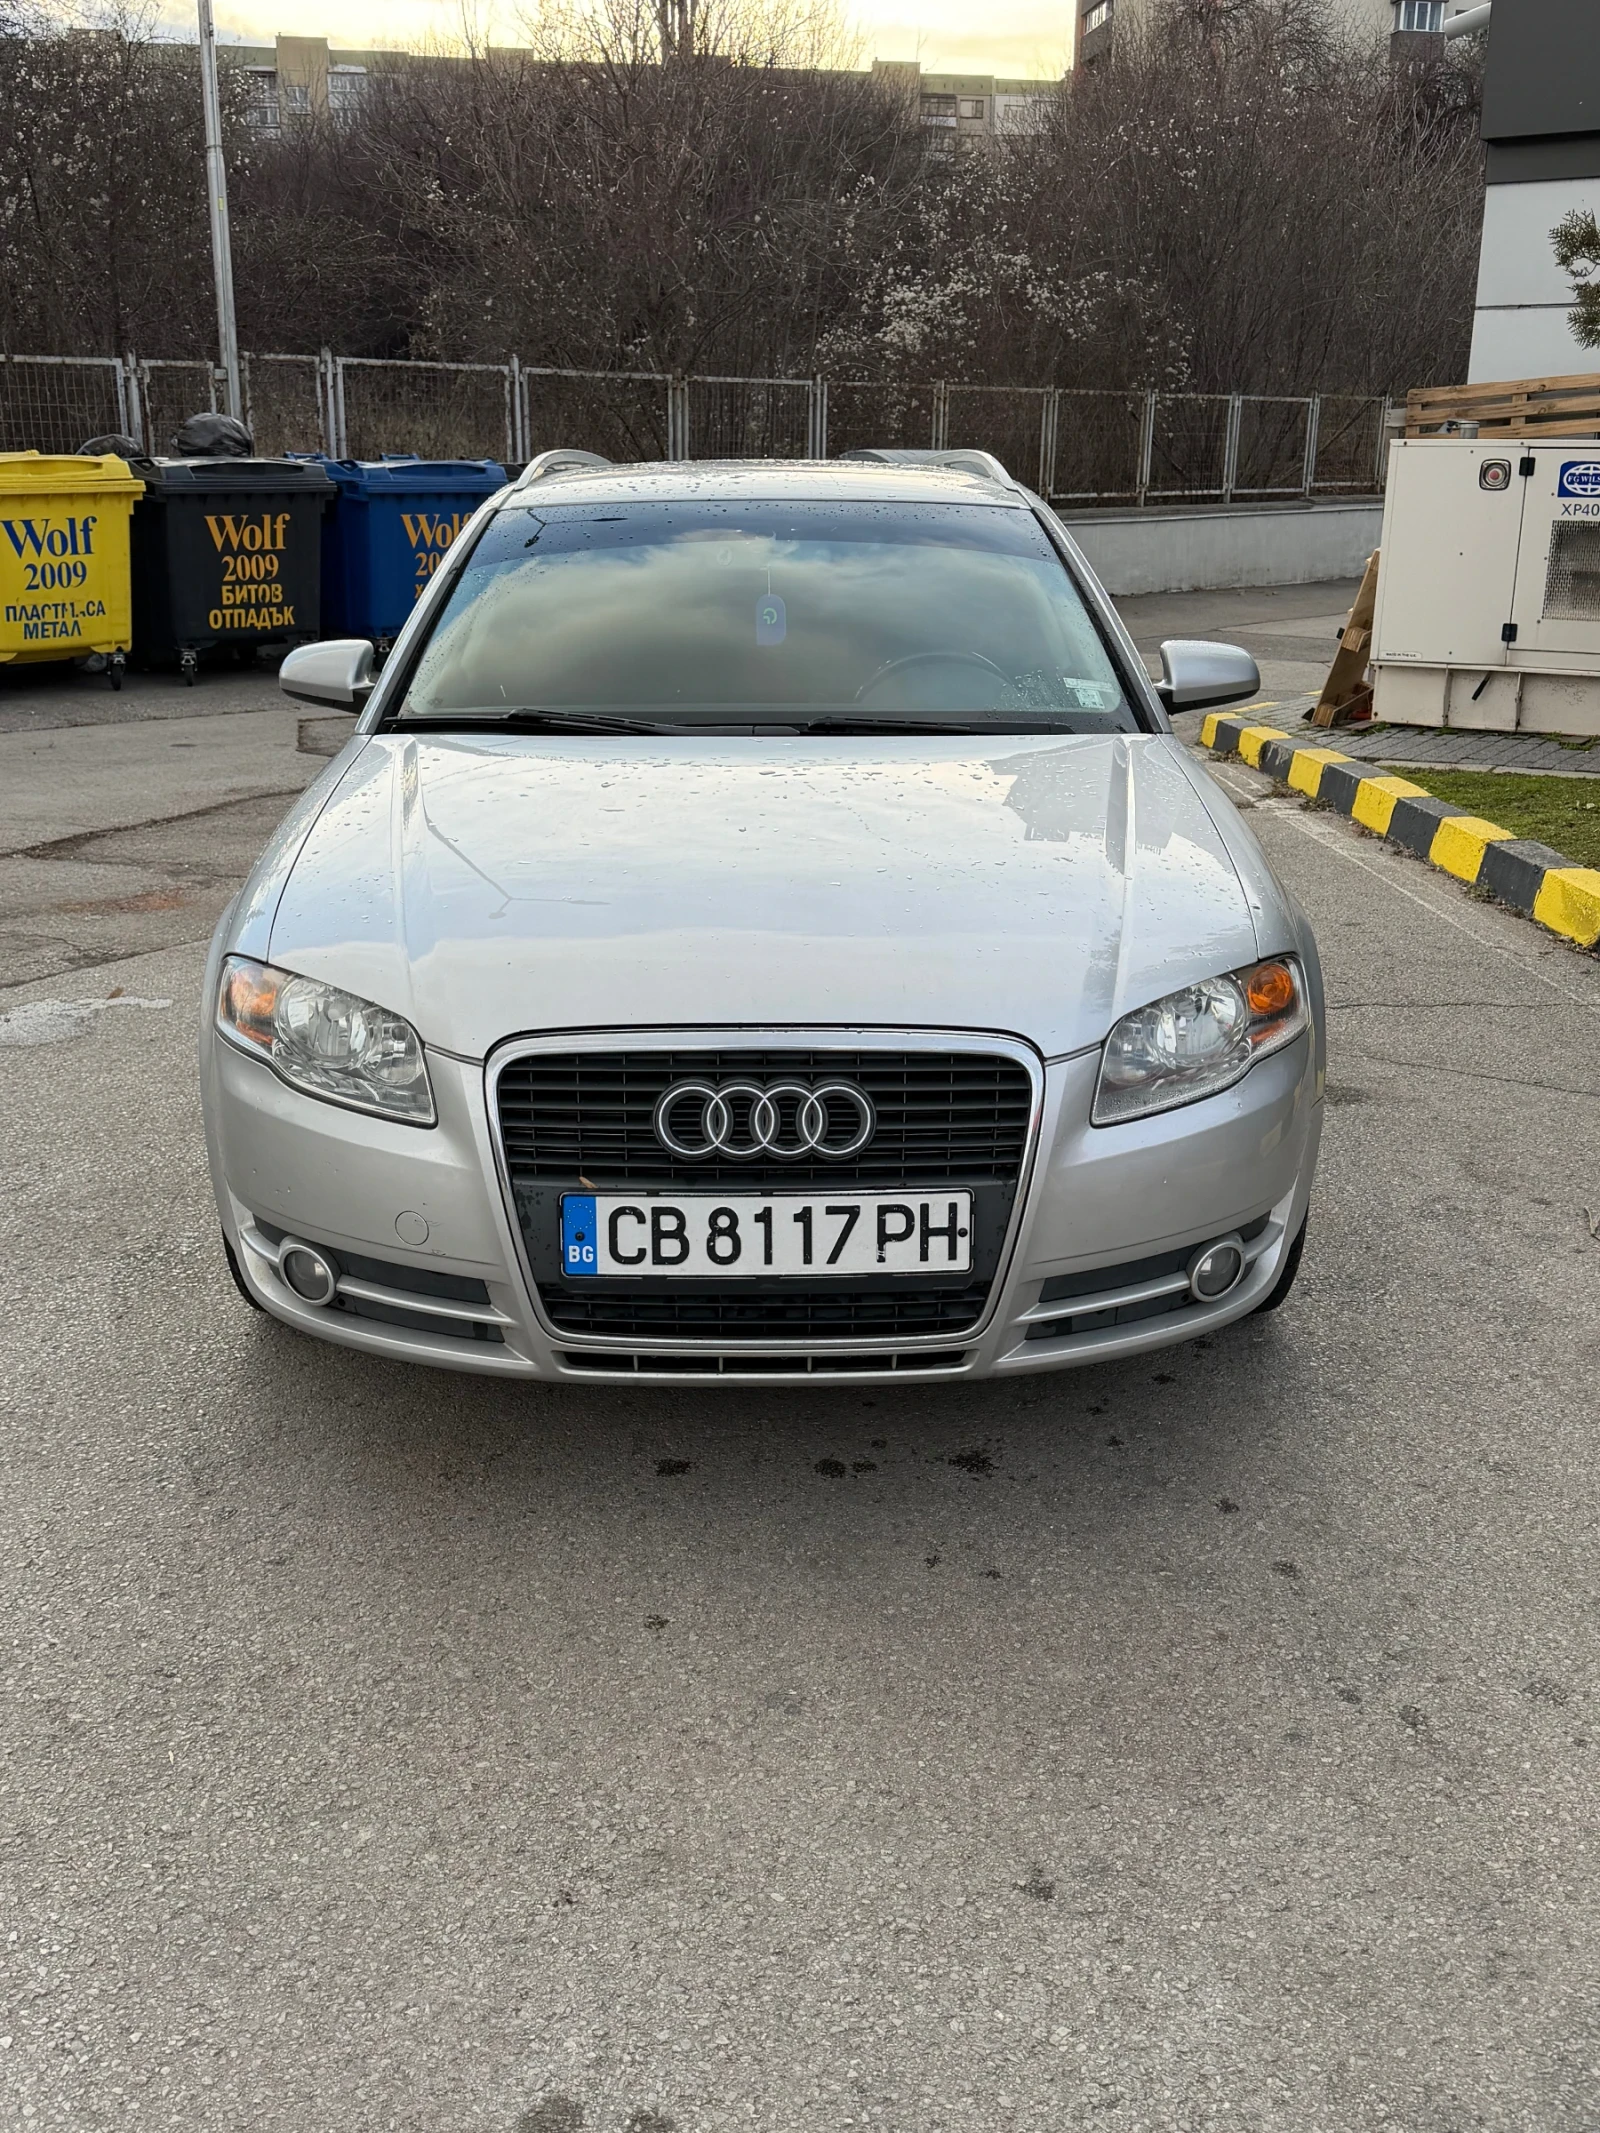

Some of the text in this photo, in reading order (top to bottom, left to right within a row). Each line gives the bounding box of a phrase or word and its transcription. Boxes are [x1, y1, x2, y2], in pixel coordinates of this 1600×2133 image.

[1567, 475, 1580, 483] FG
[1561, 503, 1600, 517] XP40
[0, 516, 98, 559] Wolf
[204, 513, 291, 552] Wolf
[24, 560, 87, 591] 2009
[221, 554, 279, 581] 2009
[415, 552, 446, 576] 20
[222, 583, 284, 606] БИТОВ
[5, 600, 106, 622] ПЛАСТМСА
[208, 605, 296, 631] ОТПАДЪК
[23, 620, 82, 640] МЕТАЛ
[609, 1202, 958, 1266] CB 8117 PH
[568, 1245, 594, 1263] BG
